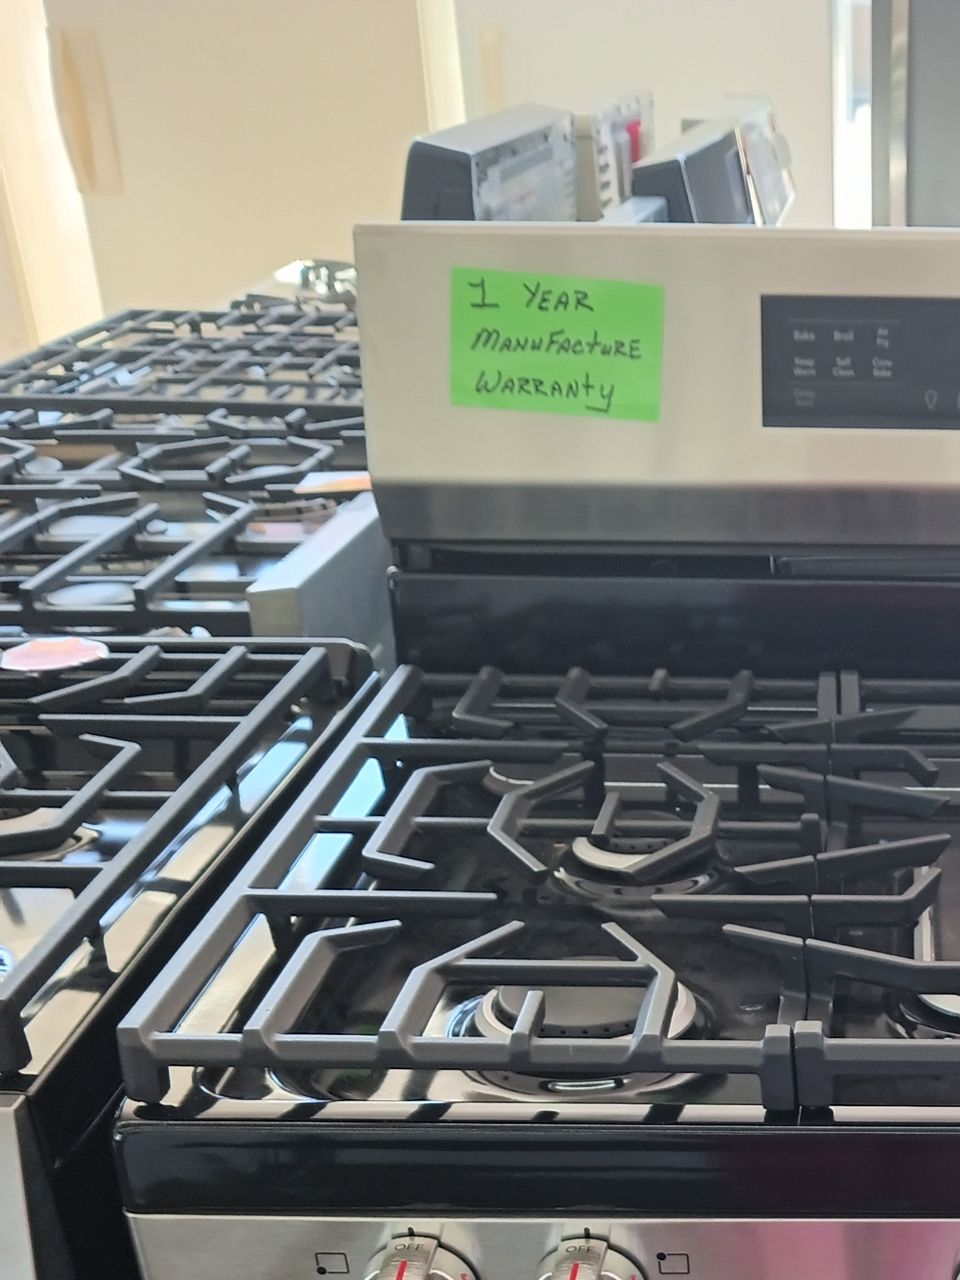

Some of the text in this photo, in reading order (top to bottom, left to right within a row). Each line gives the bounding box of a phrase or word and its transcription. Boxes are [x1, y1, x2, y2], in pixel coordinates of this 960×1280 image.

[467, 277, 594, 312] 1 YEAR
[394, 1242, 425, 1253] OFF
[565, 1244, 594, 1254] OFF
